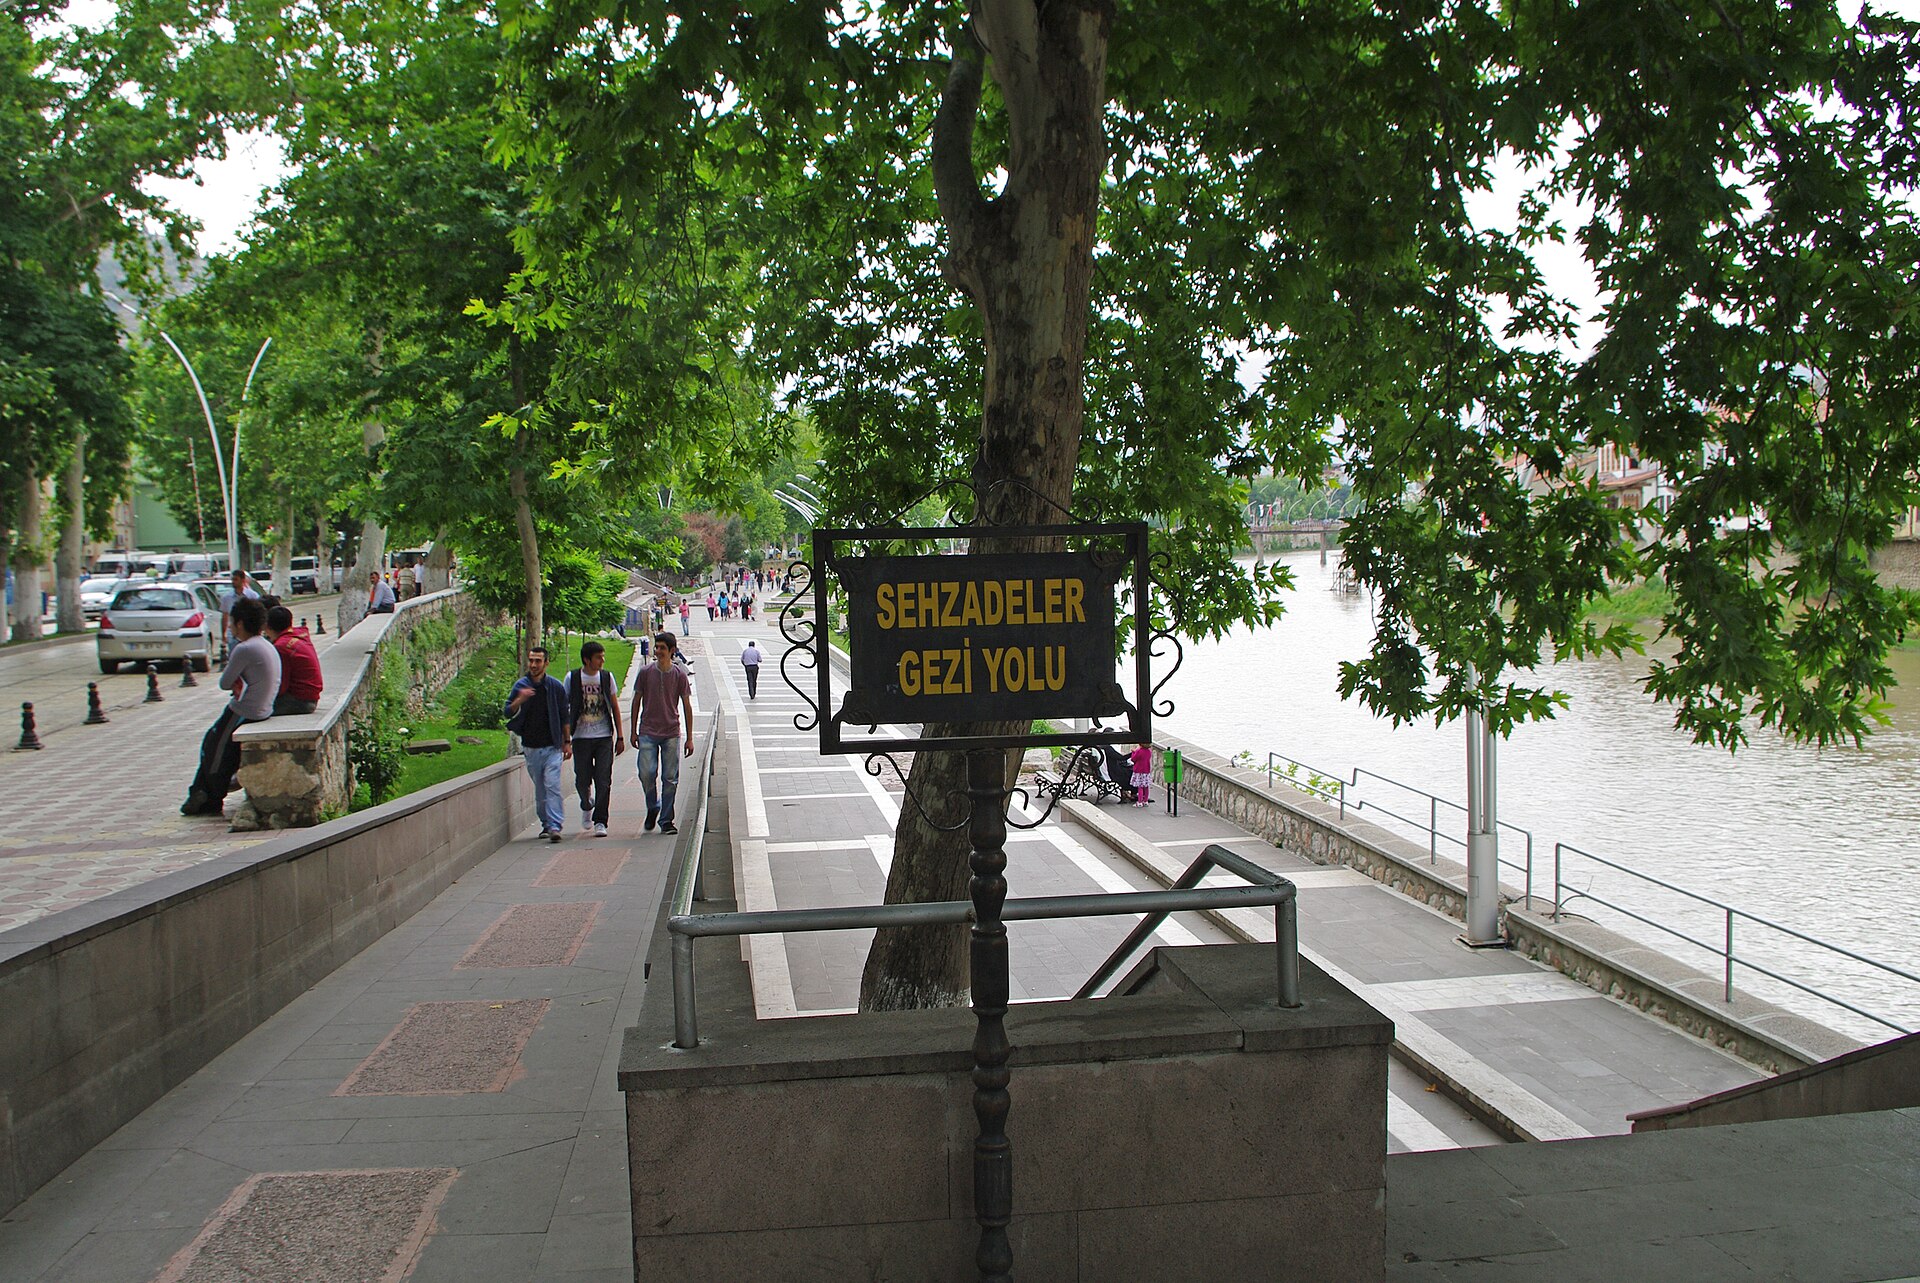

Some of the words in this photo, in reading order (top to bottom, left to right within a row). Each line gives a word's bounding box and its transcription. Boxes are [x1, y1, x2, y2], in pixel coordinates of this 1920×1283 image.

[876, 578, 1086, 630] SEHZADELER
[899, 637, 972, 696] GEZİ
[982, 645, 1066, 693] YOLU
